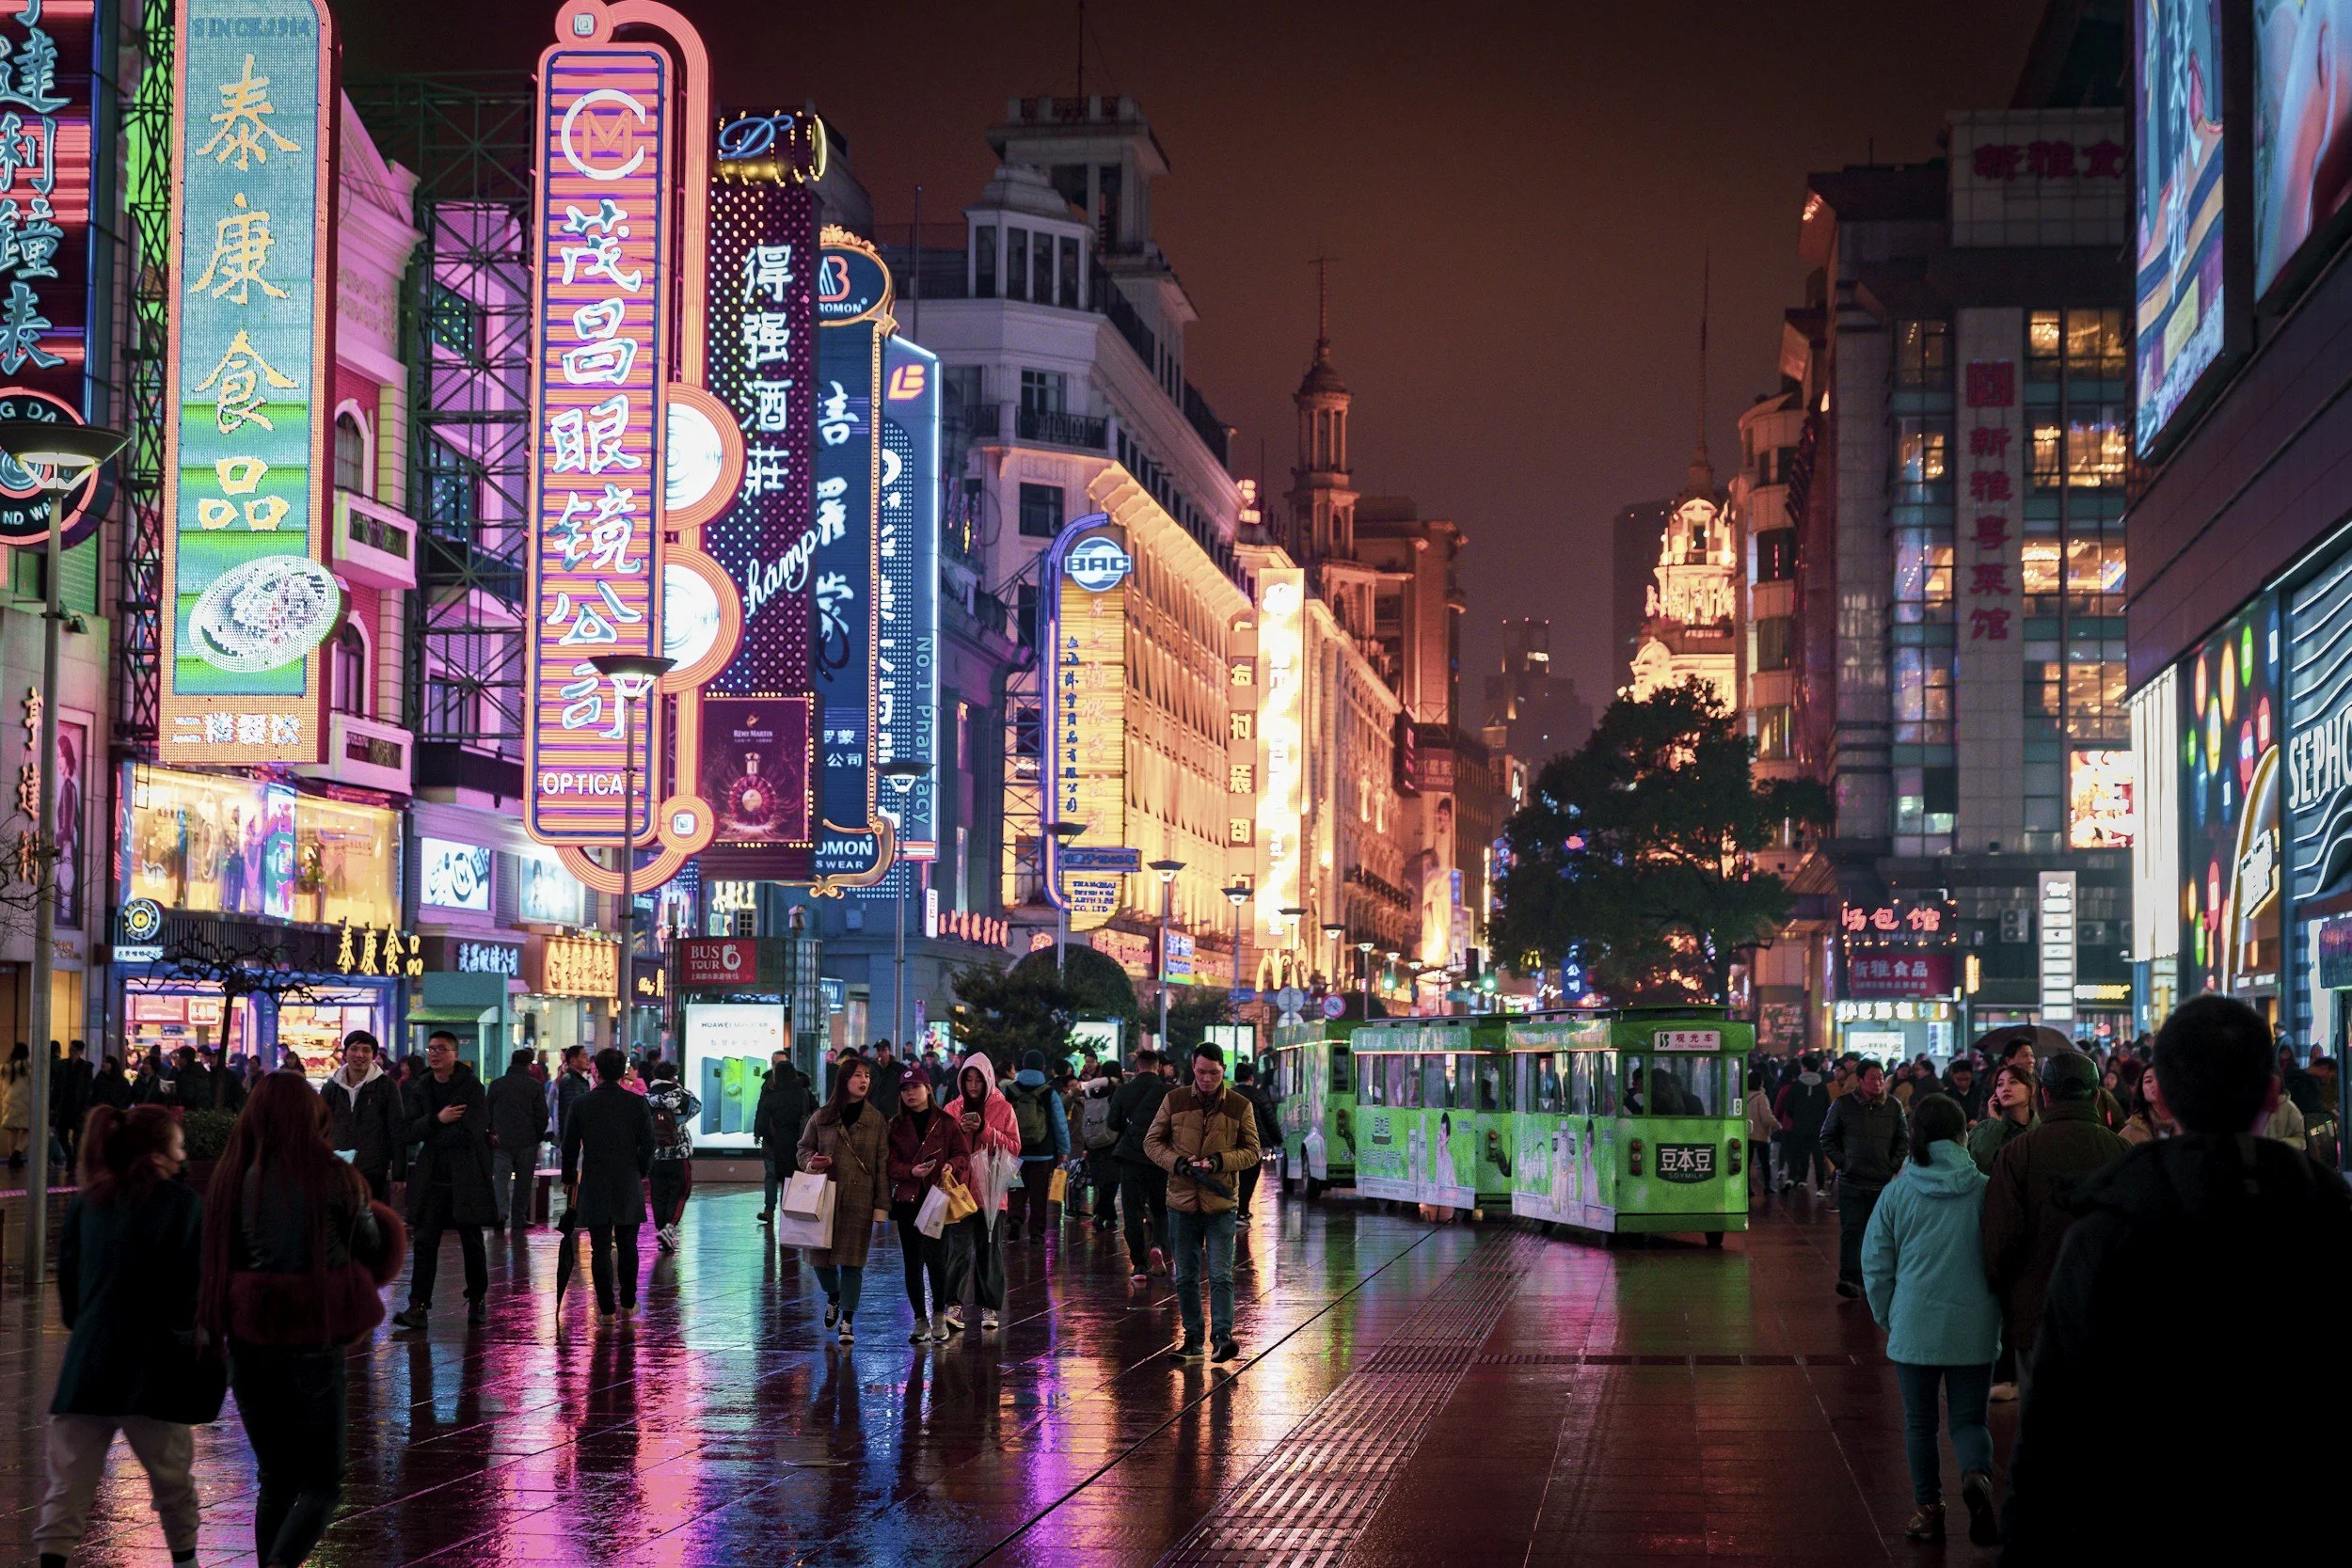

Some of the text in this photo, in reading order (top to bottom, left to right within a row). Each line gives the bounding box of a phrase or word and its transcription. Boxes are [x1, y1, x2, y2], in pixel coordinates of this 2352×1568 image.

[189, 54, 301, 531] 泰康食品
[547, 198, 644, 739] 茂昌眼镜公司
[1067, 557, 1130, 572] BAC
[912, 705, 932, 825] Pharacy
[542, 772, 640, 797] OPTICA
[825, 861, 865, 869] WEAR
[336, 916, 424, 976] 泰康食品
[691, 944, 720, 959] BUS
[690, 959, 721, 970] TOUR
[1676, 1033, 1714, 1044] 观光车
[1660, 1147, 1712, 1172] 豆本豆
[1667, 1171, 1705, 1180] SOYMILK
